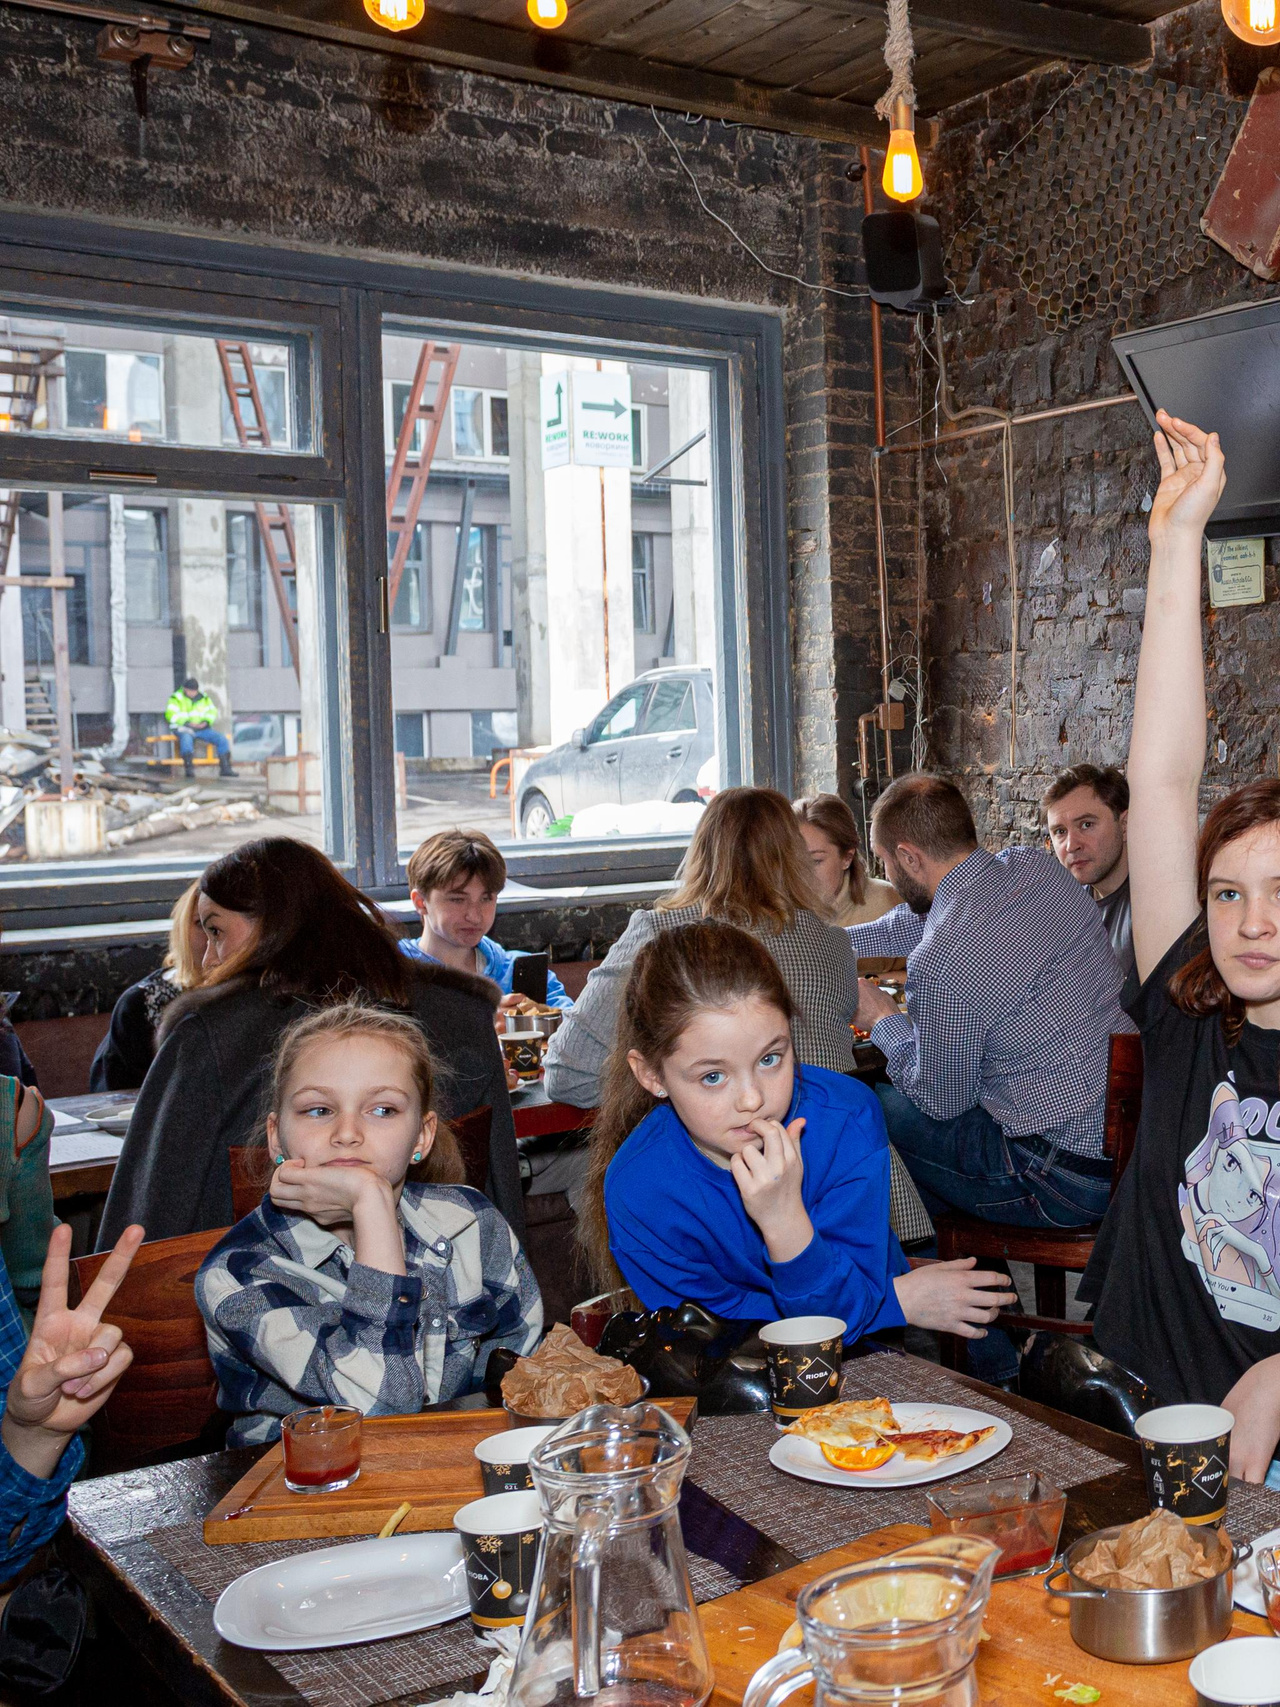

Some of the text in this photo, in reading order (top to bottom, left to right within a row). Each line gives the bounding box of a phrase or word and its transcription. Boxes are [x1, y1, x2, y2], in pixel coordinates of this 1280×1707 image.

[583, 430, 630, 442] RE:WORK
[1218, 1282, 1230, 1292] You
[805, 1370, 829, 1381] RIOBA
[1201, 1470, 1223, 1483] RIOBA
